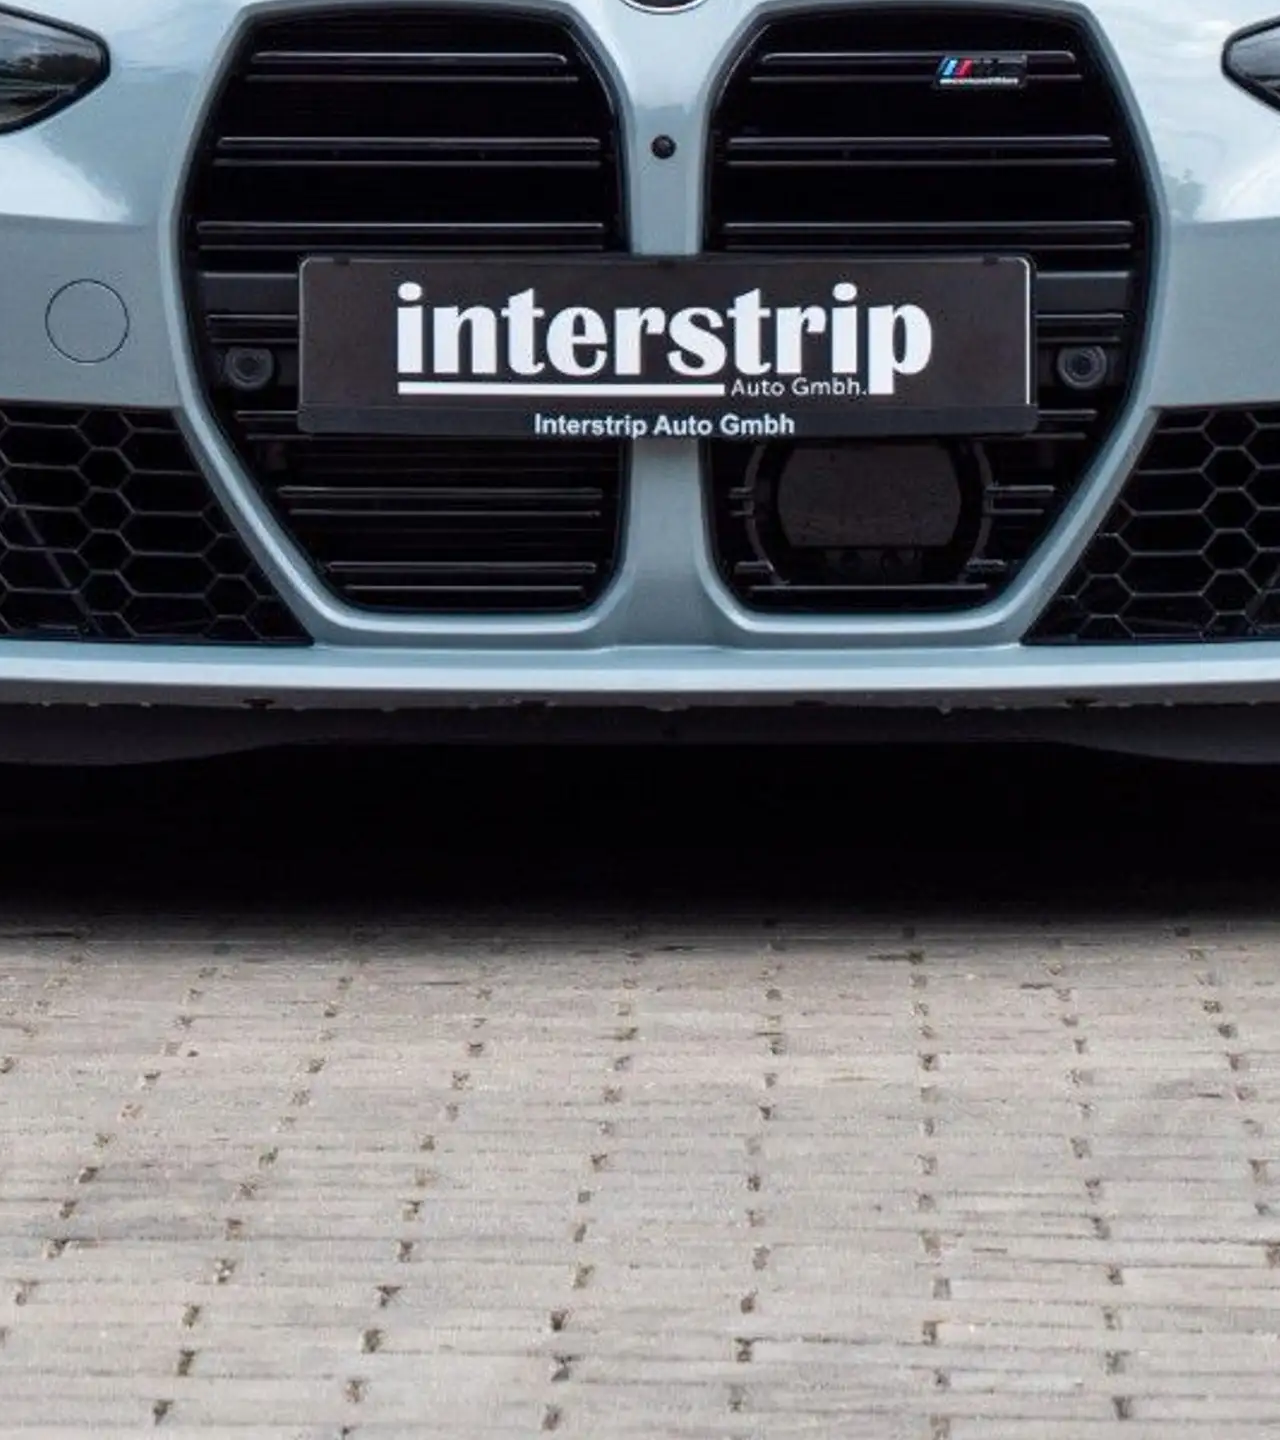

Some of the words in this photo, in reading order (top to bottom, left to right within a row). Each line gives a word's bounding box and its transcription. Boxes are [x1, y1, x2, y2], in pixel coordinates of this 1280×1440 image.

[397, 281, 933, 395] interstrip
[731, 378, 786, 397] Auto
[534, 412, 648, 440] Interstrip
[652, 414, 713, 436] Auto
[719, 413, 795, 436] Gmbh
